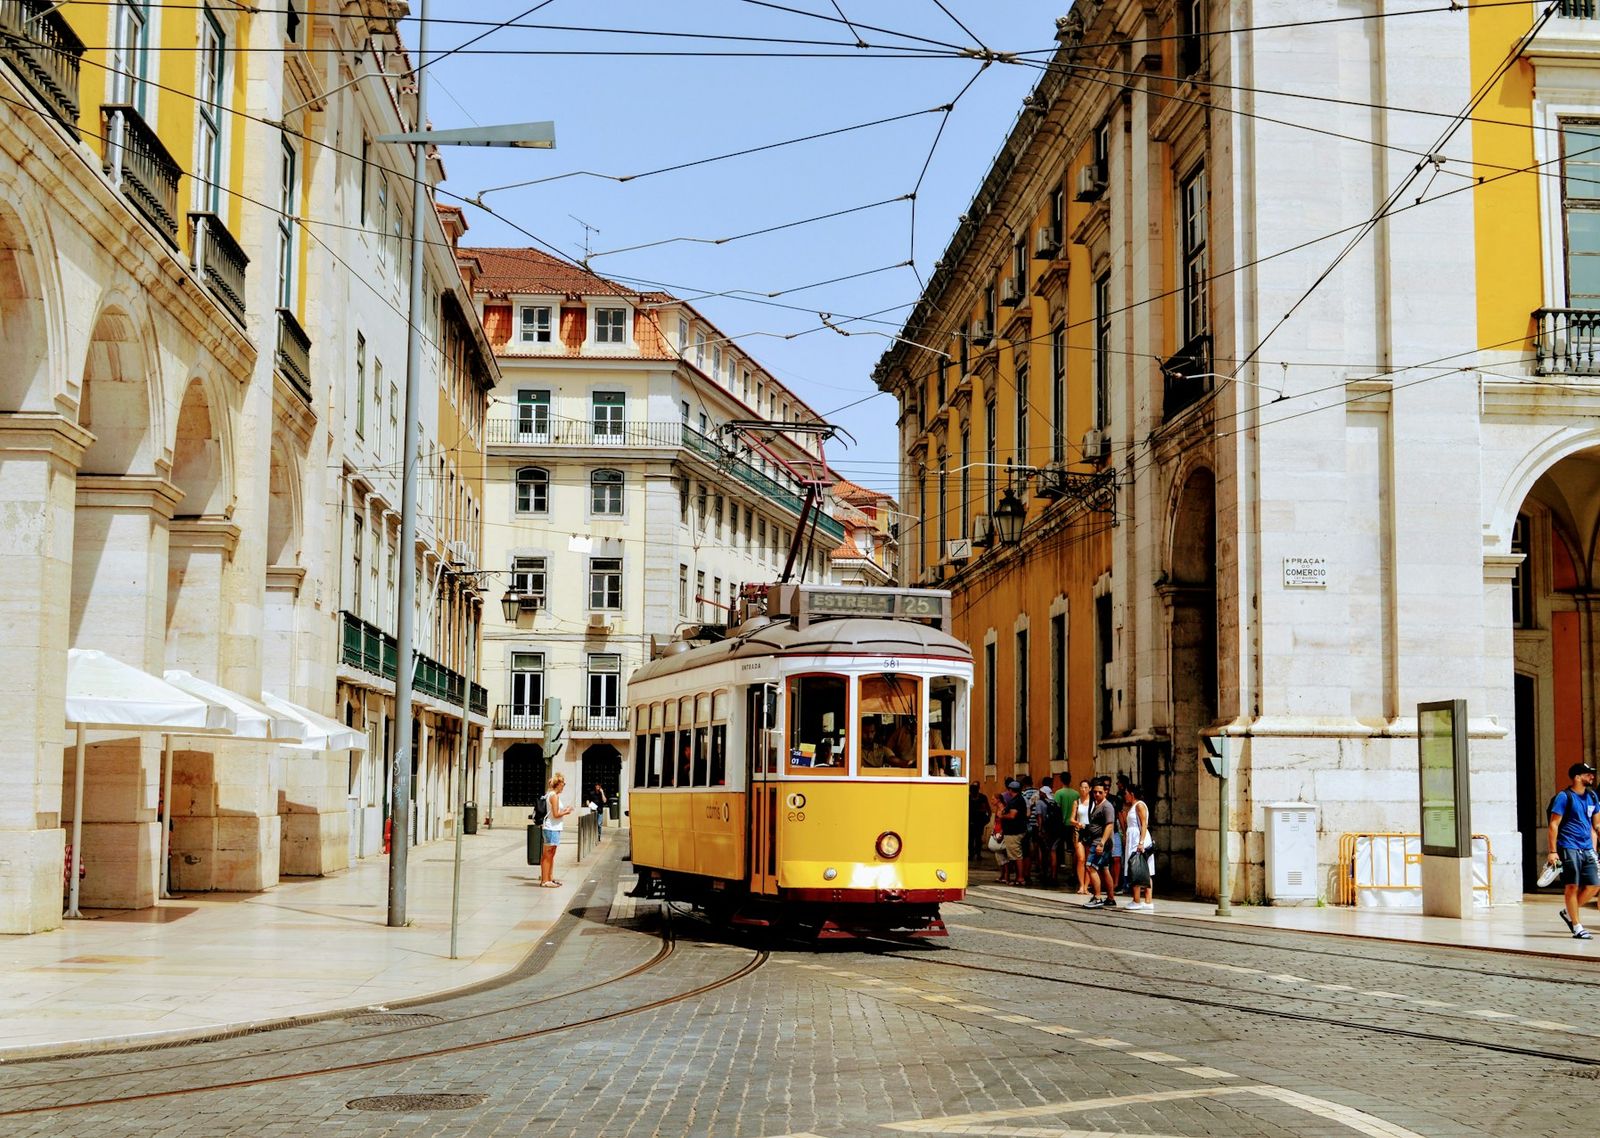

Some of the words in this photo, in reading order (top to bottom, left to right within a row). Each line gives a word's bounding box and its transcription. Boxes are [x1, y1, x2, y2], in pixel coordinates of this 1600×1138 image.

[1286, 568, 1326, 576] COMERCIO
[904, 597, 930, 613] 25
[883, 660, 900, 668] 581
